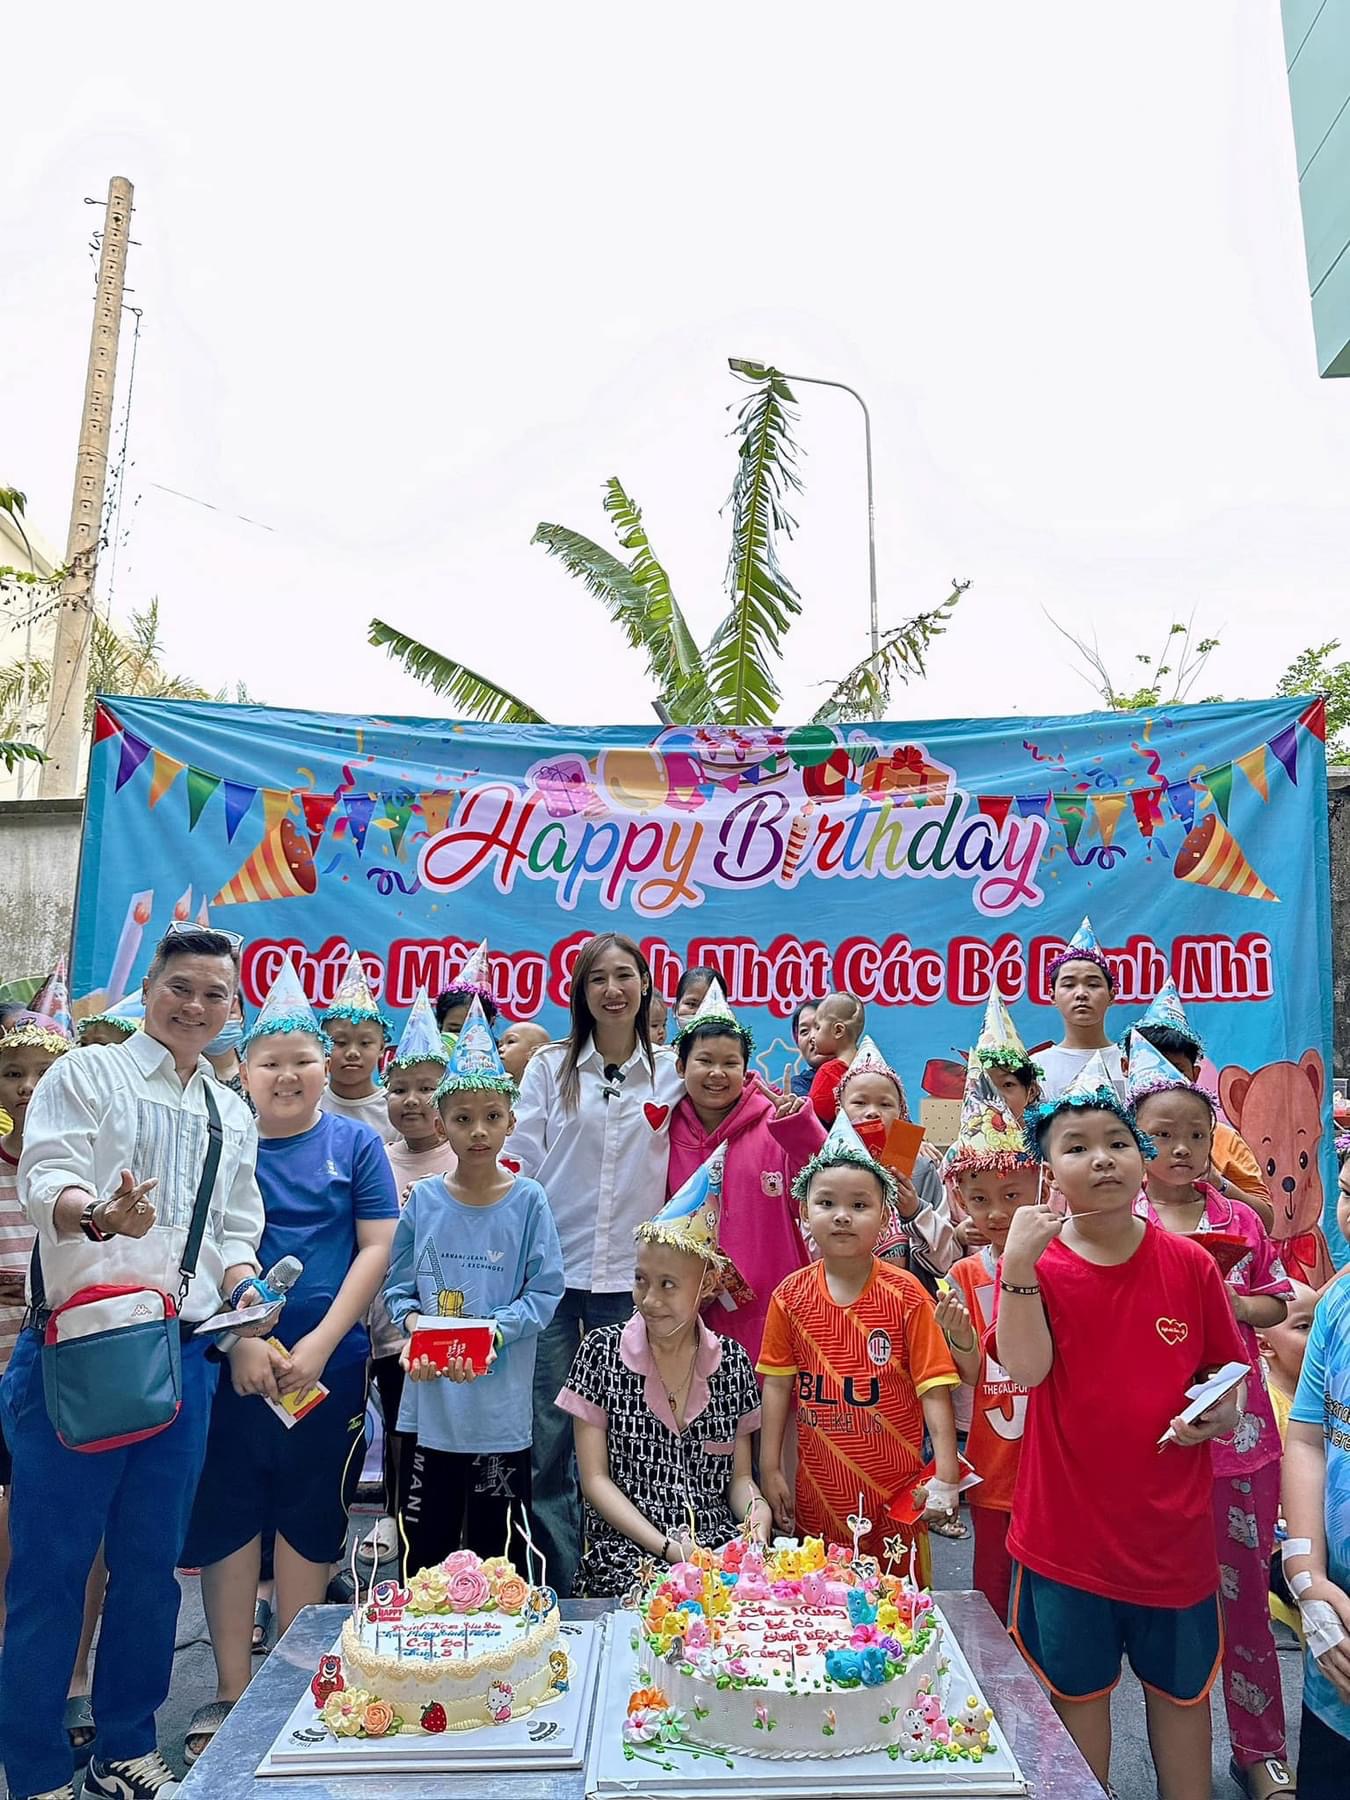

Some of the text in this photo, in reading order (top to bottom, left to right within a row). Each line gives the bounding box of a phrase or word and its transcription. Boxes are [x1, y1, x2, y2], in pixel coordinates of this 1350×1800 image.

[423, 783, 1038, 911] Happy Birthday
[698, 940, 833, 1014] Nhật
[844, 939, 945, 1003] Các
[957, 938, 1027, 1002] Bé
[1178, 937, 1275, 998] Nhi
[799, 1371, 880, 1407] BLU
[983, 1383, 998, 1395] THE
[405, 1452, 425, 1523] MANI
